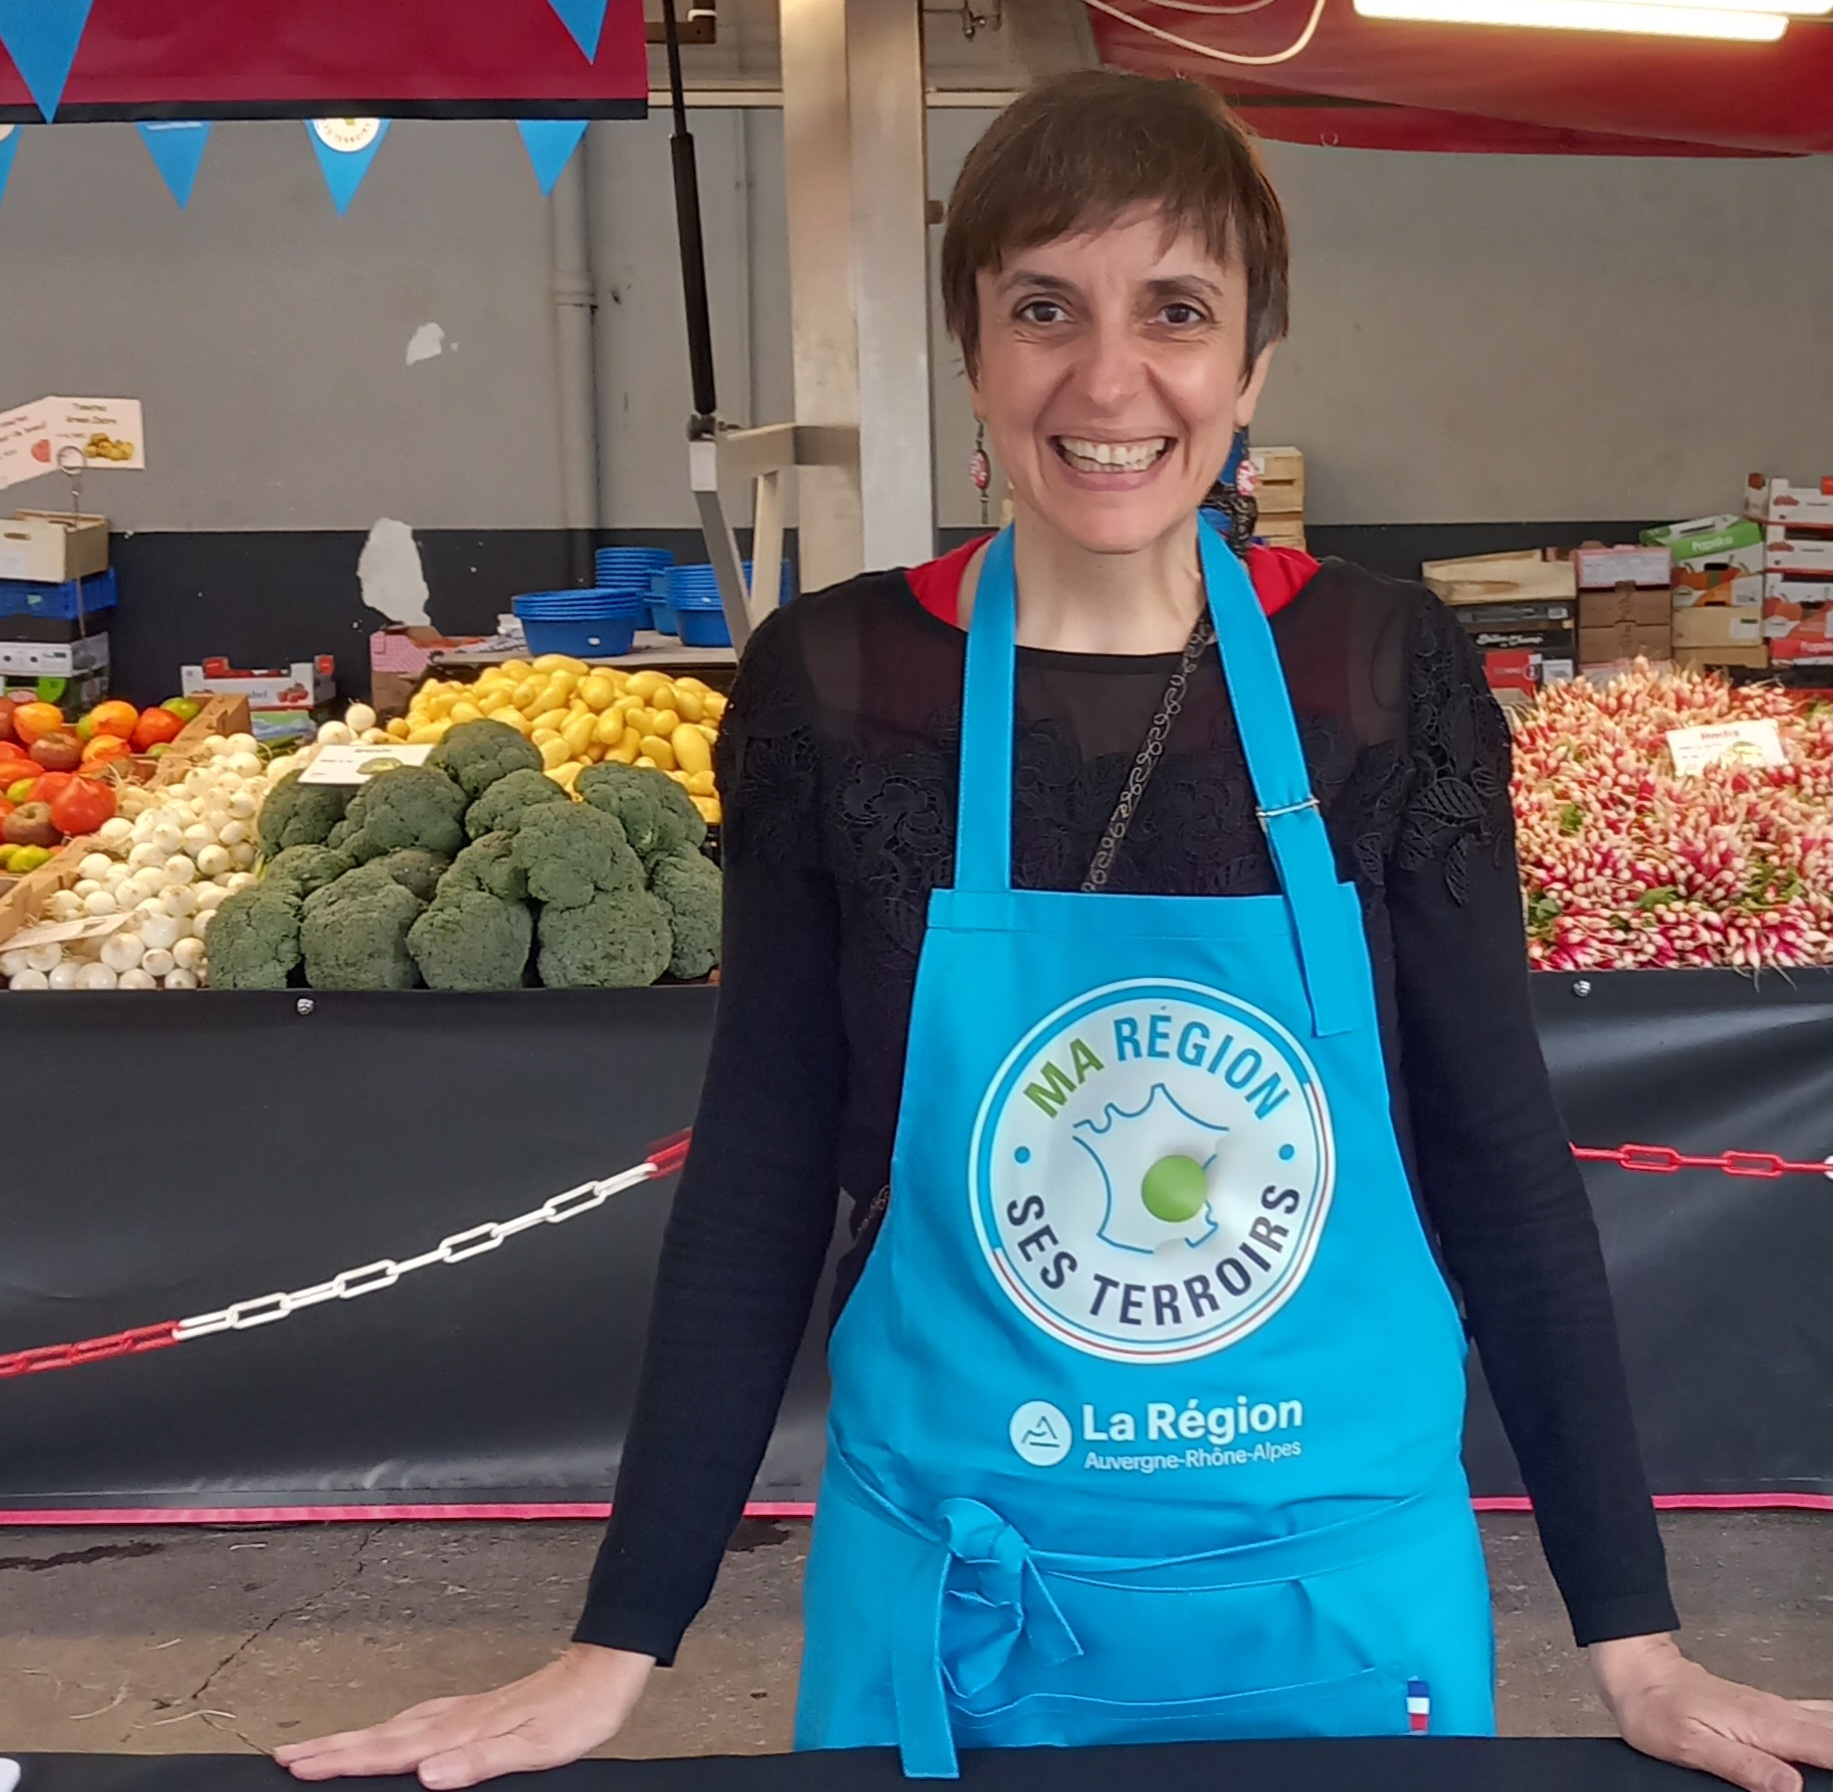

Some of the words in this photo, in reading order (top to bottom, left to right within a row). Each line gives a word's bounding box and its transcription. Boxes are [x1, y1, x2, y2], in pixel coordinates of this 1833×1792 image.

[1023, 1037, 1105, 1120] MA
[1113, 1005, 1292, 1121] RÉGION
[1007, 1194, 1078, 1291] SES
[1088, 1184, 1301, 1326] TERROIRS
[1082, 1403, 1135, 1442] La
[1146, 1395, 1304, 1445] Région
[1084, 1440, 1302, 1474] Auvergne-Rhône-Alpes
